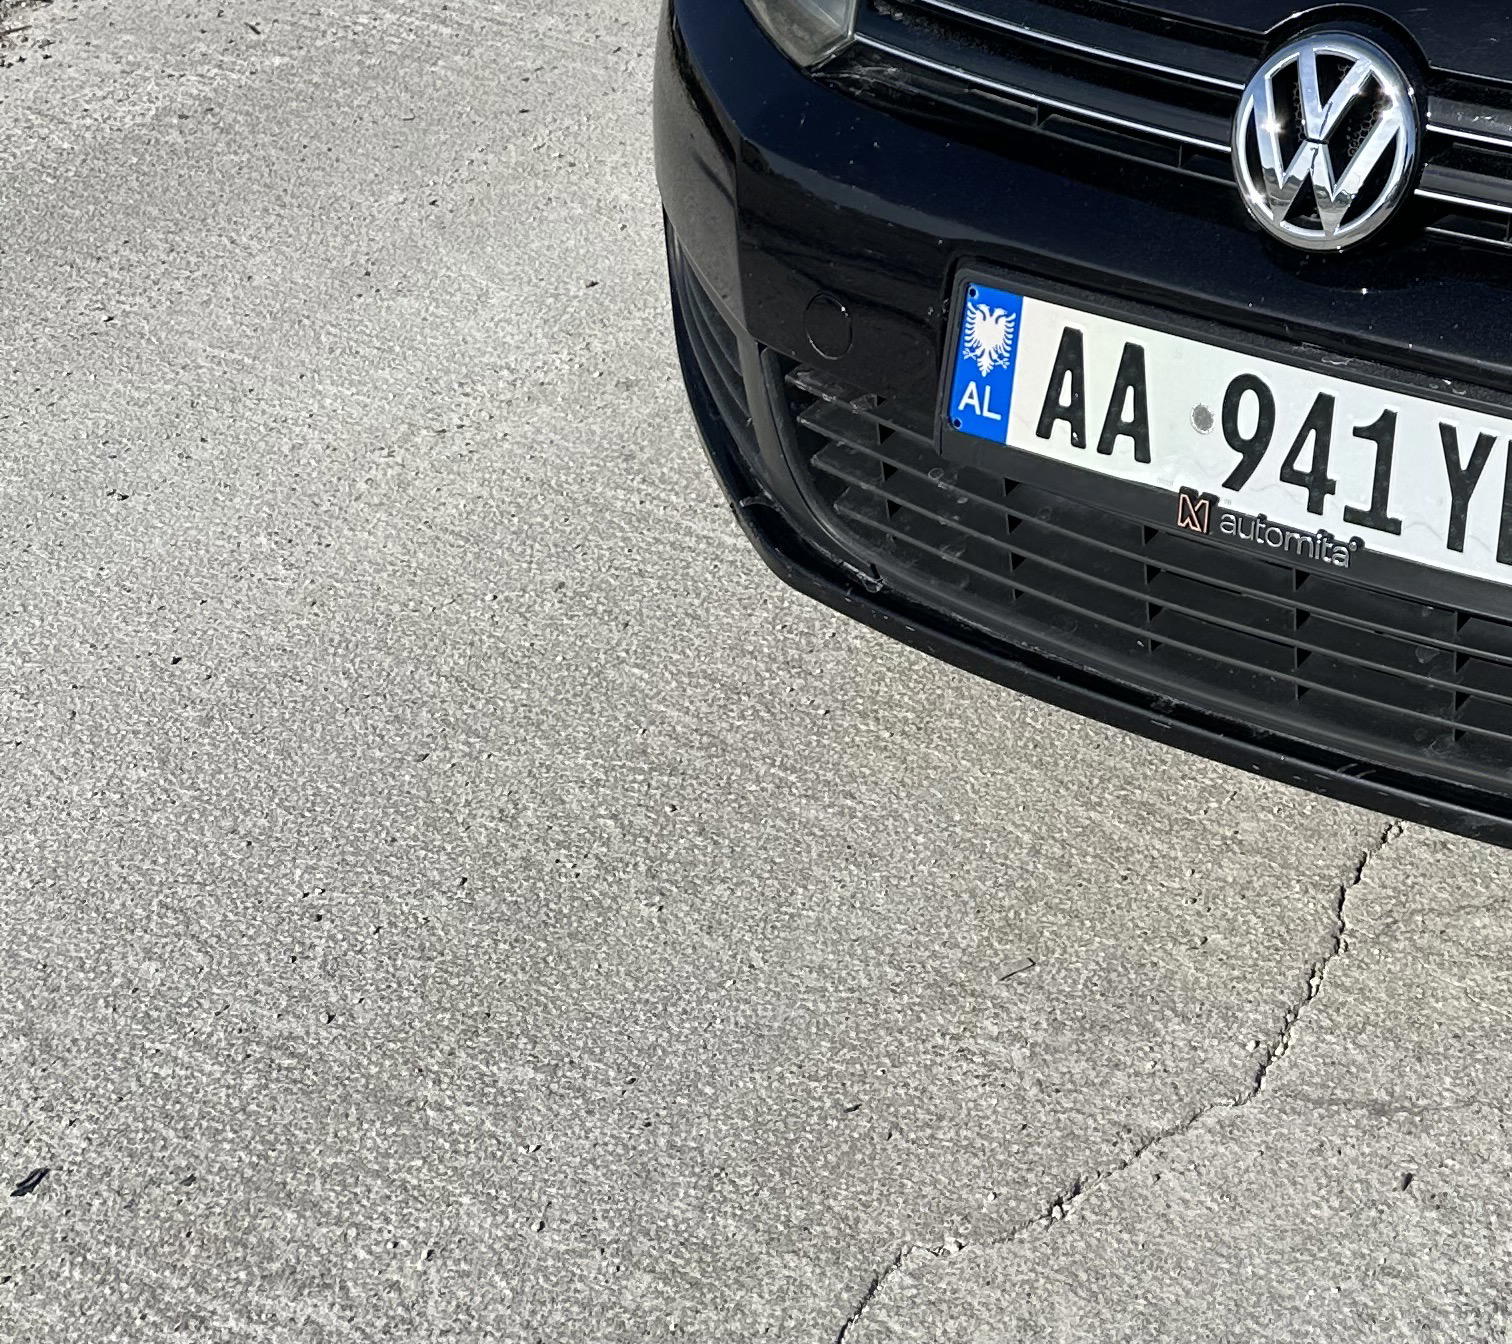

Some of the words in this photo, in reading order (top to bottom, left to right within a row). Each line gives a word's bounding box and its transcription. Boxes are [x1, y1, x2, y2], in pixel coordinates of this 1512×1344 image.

[958, 380, 1002, 421] AL
[1035, 325, 1152, 465] AA
[1221, 372, 1402, 536] 941
[1219, 512, 1350, 568] automita
